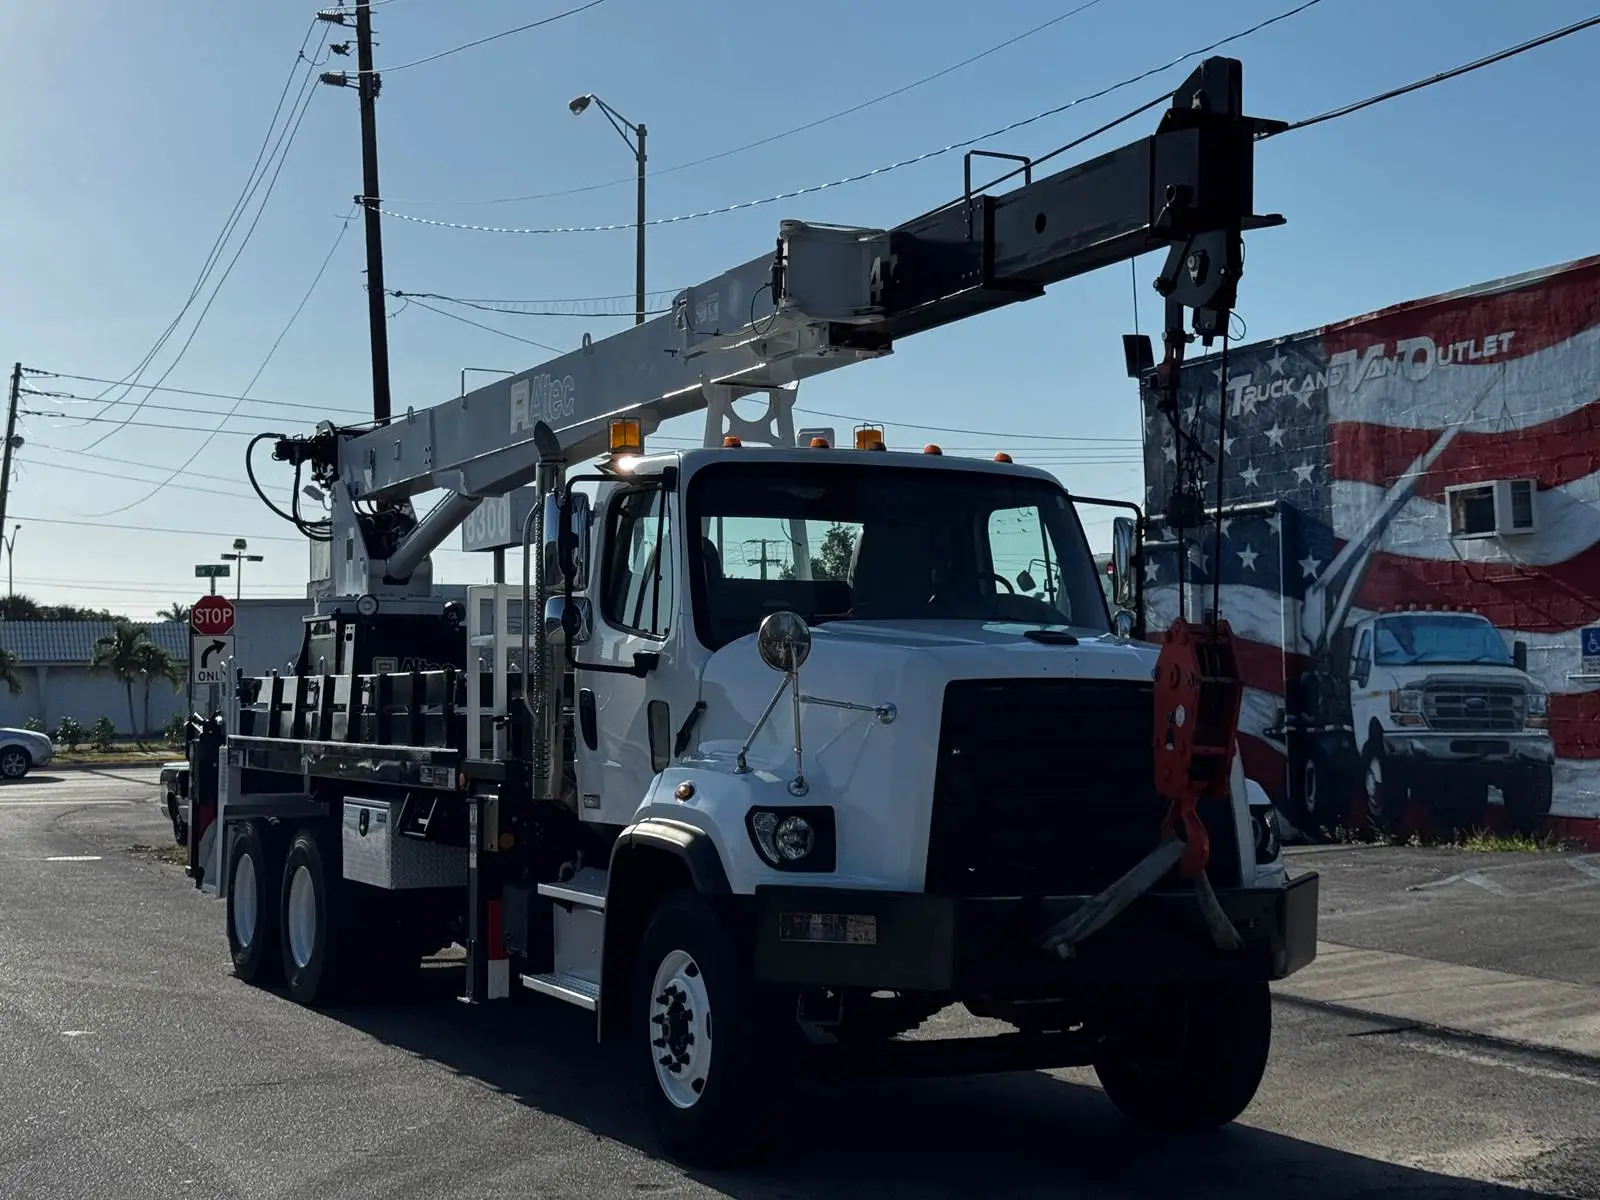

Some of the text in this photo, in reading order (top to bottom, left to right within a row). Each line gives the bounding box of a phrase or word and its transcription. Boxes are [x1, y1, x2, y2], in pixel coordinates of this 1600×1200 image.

[529, 373, 575, 427] Altec
[1226, 373, 1297, 417] TRUCK
[1328, 343, 1398, 393] VAN
[1397, 331, 1515, 382] OUTLET
[195, 608, 232, 624] STOP
